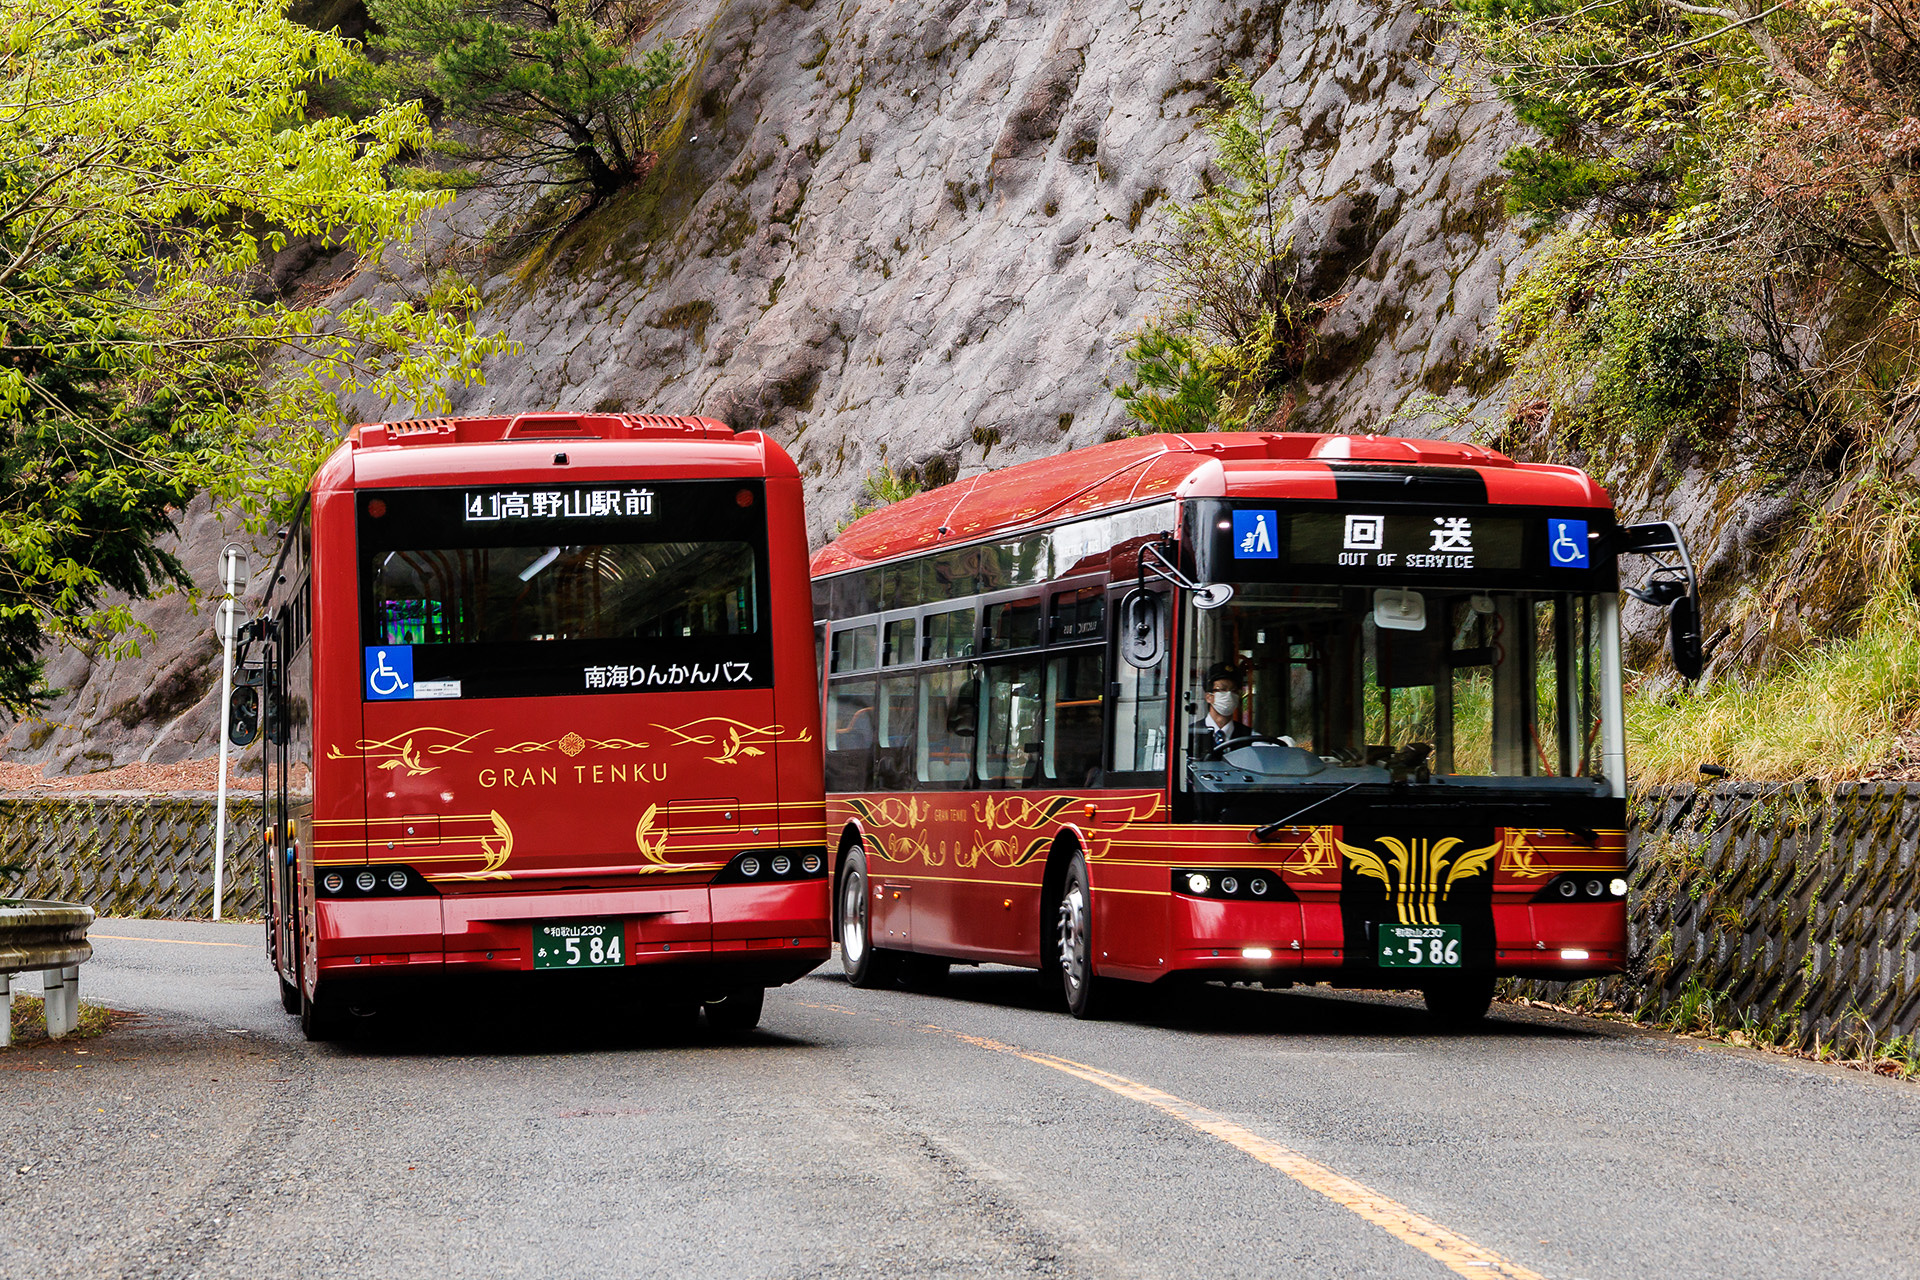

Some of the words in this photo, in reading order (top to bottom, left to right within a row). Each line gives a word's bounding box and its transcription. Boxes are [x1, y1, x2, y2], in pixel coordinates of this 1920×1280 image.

[500, 488, 655, 519] 高野山駅前
[1338, 552, 1368, 566] OUT
[1377, 553, 1397, 567] OF
[1405, 554, 1475, 569] SERVICE
[584, 661, 753, 688] 南海りんかんバス
[478, 766, 557, 788] GRAN
[573, 762, 667, 784] TENKU
[537, 947, 547, 958] あ
